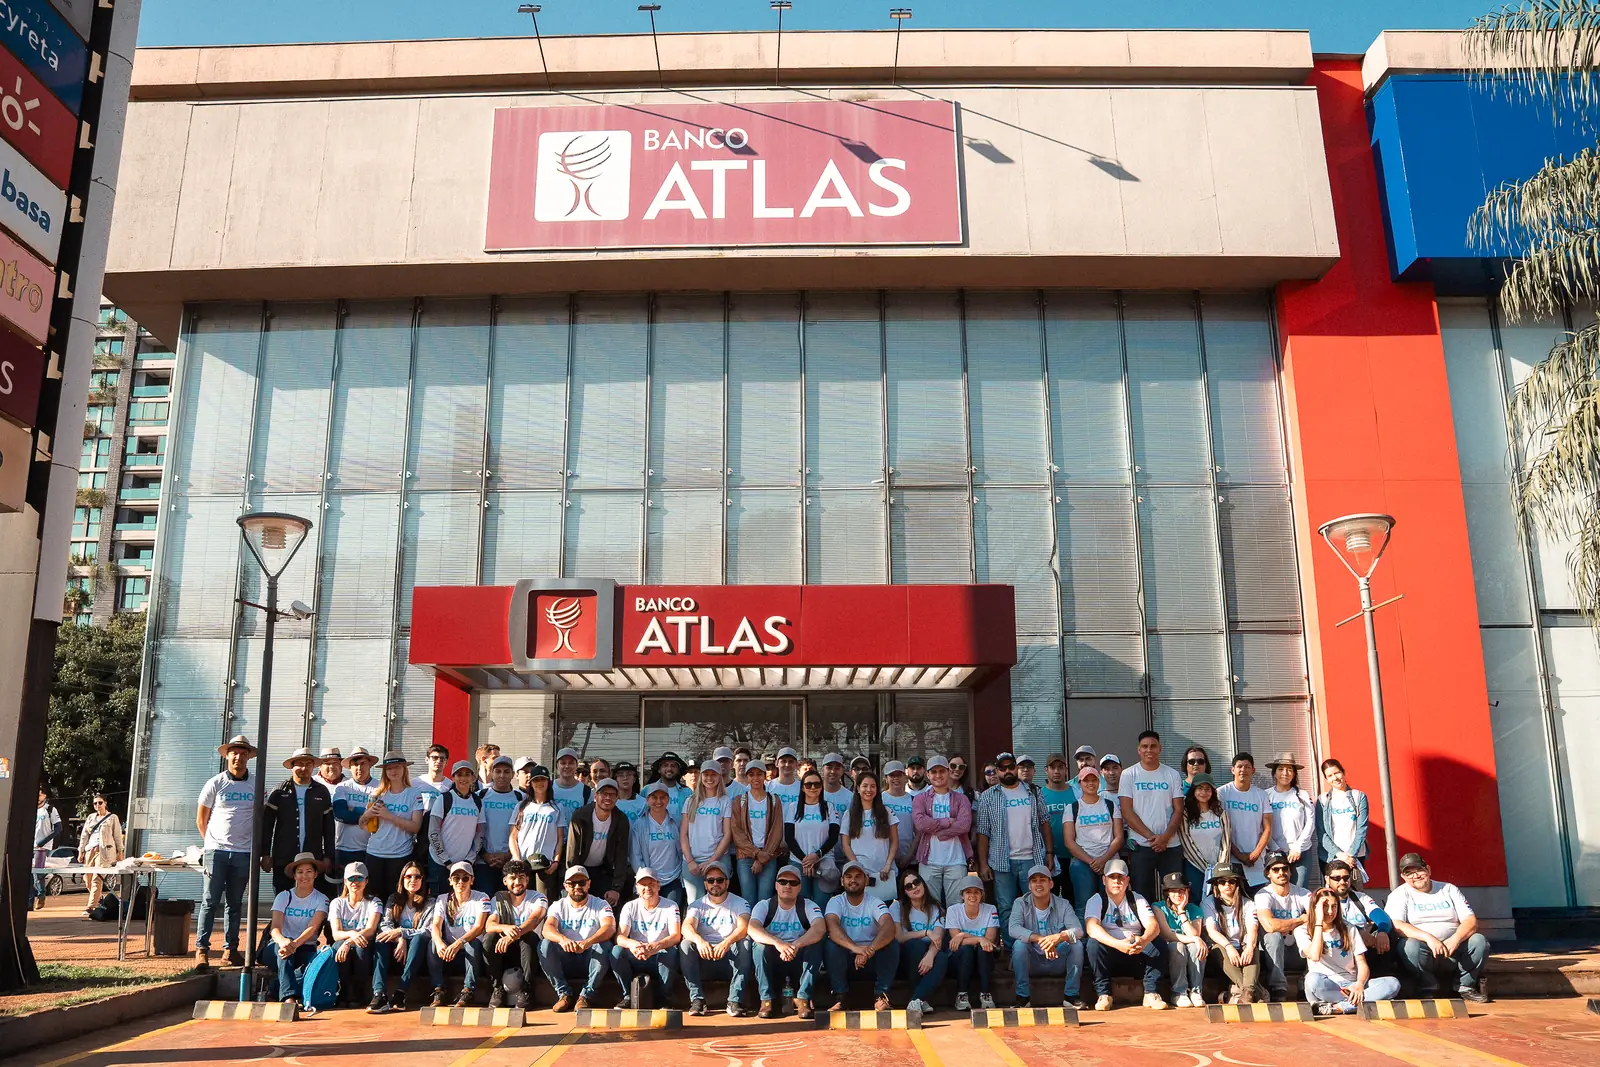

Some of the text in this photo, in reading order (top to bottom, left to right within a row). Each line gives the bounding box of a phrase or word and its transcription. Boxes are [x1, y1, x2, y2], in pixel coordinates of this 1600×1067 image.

[644, 128, 748, 151] BANCO
[642, 158, 911, 220] ATLAS
[1, 168, 51, 233] basa
[635, 597, 695, 612] BANCO
[635, 616, 789, 654] ATLAS
[1135, 782, 1169, 791] TECHO
[220, 792, 255, 801] TECHO
[348, 793, 368, 802] TECH
[1006, 798, 1031, 808] ECHO
[1047, 803, 1064, 812] TEC
[1227, 800, 1259, 812] TECHO
[1272, 801, 1300, 810] ECHO
[698, 807, 720, 816] CHO
[750, 810, 767, 819] ECH
[1079, 813, 1110, 825] TECHO
[1413, 901, 1451, 912] TECHO
[769, 921, 801, 932] TECHO
[841, 915, 871, 927] TECHO
